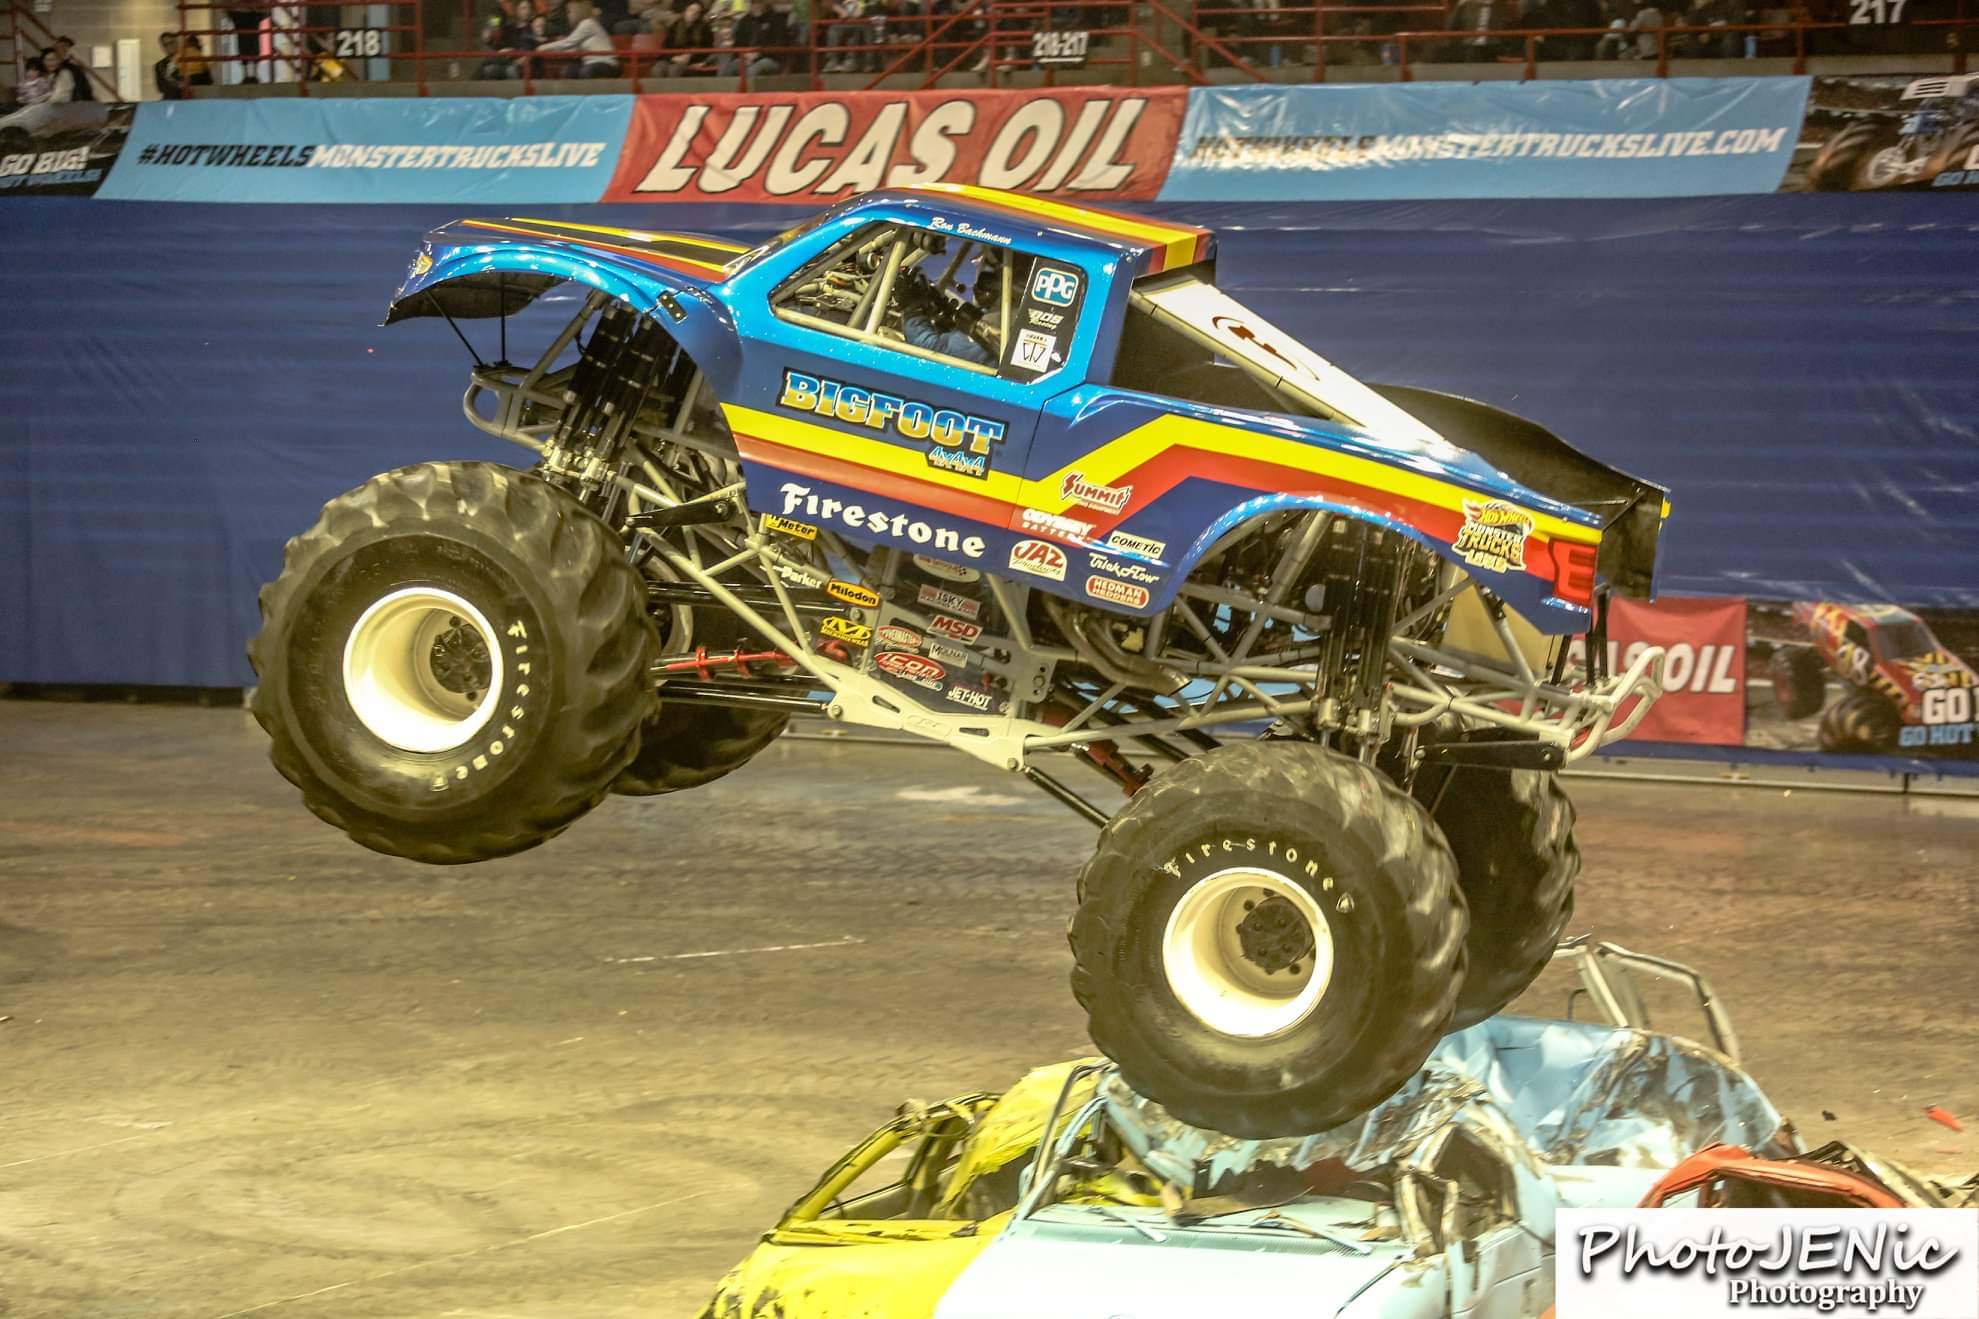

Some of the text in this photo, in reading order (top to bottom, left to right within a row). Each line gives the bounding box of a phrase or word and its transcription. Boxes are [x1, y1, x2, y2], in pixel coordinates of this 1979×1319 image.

[1849, 0, 1903, 24] 217
[337, 30, 380, 57] 218
[1032, 31, 1089, 57] 218-217
[31, 146, 90, 174] BIG!
[138, 142, 606, 169] #HOTWHEELSMONSTERTRUCKSLIVE
[634, 98, 1150, 196] LUCAS OIL
[927, 217, 954, 231] Ron
[1036, 273, 1075, 300] PPG
[780, 371, 1006, 455] BIGFOOT
[1063, 473, 1129, 507] SUMMIT
[780, 483, 986, 558] Firestone
[1014, 542, 1063, 569] JAZ
[1110, 534, 1161, 555] COMETIC
[1461, 528, 1522, 561] TRUCKS
[781, 566, 822, 589] Parker
[1093, 579, 1144, 599] HEDMAN
[830, 583, 876, 605] Milodon
[933, 616, 978, 638] MSD
[1663, 642, 1737, 694] OIL
[1922, 687, 1970, 725] GO
